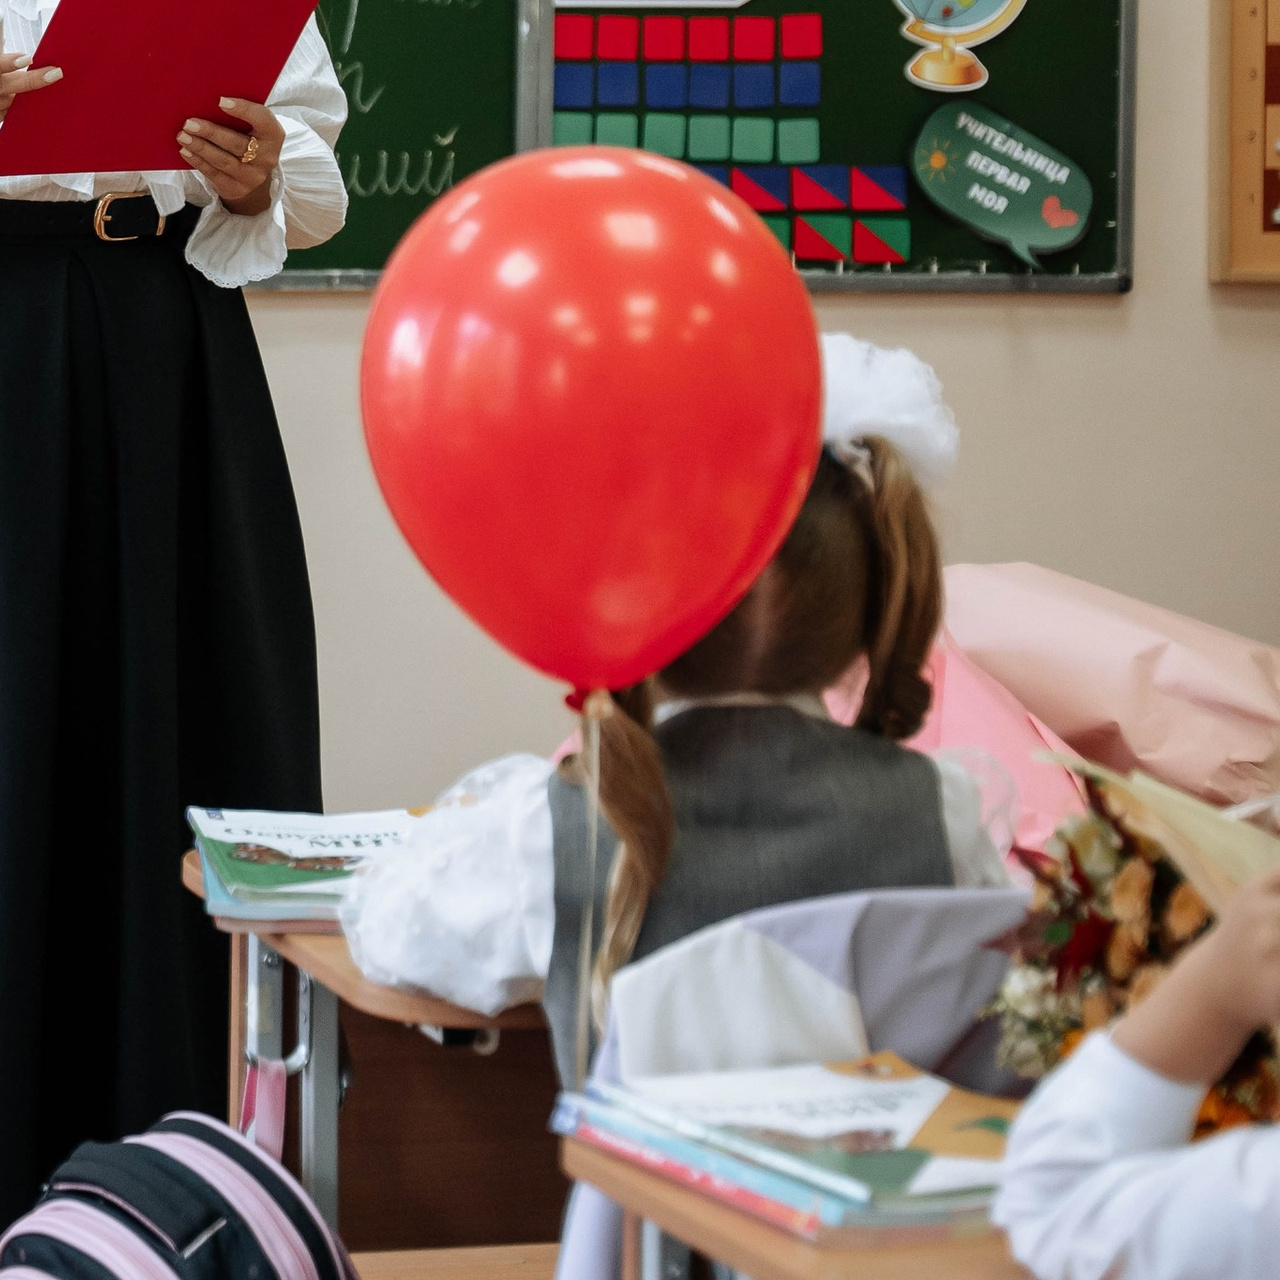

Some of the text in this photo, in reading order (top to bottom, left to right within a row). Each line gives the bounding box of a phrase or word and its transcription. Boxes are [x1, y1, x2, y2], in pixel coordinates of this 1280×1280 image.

[956, 111, 1072, 184] УЧИТЕЛЬНИЦА
[966, 149, 1032, 195] ПЕРВАЯ
[968, 182, 1010, 215] МОЯ
